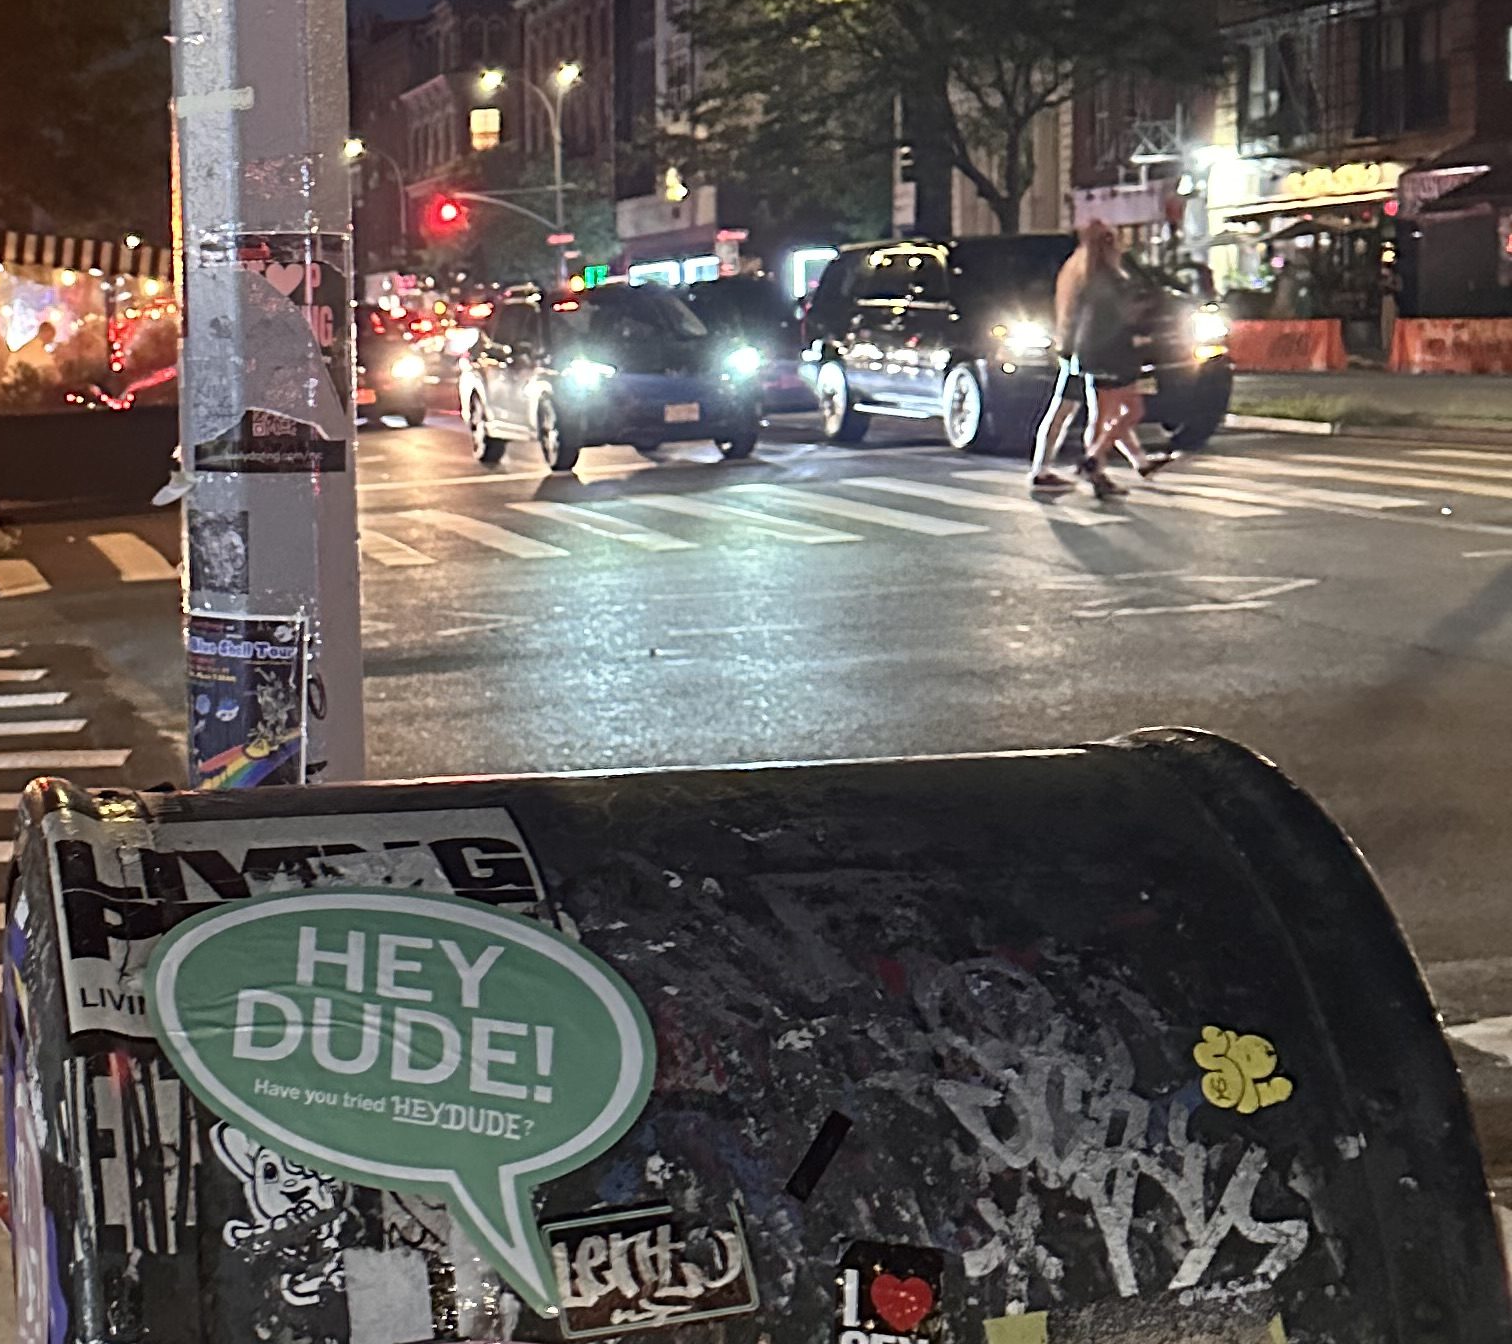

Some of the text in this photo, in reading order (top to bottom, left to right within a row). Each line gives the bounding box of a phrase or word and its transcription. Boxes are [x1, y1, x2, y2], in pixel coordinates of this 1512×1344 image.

[254, 641, 299, 660] Tour
[295, 926, 506, 1009] HEY
[232, 988, 555, 1104] DUDE!
[253, 1078, 301, 1101] Have
[303, 1089, 338, 1107] you
[342, 1093, 387, 1113] tried
[842, 1268, 860, 1328] I
